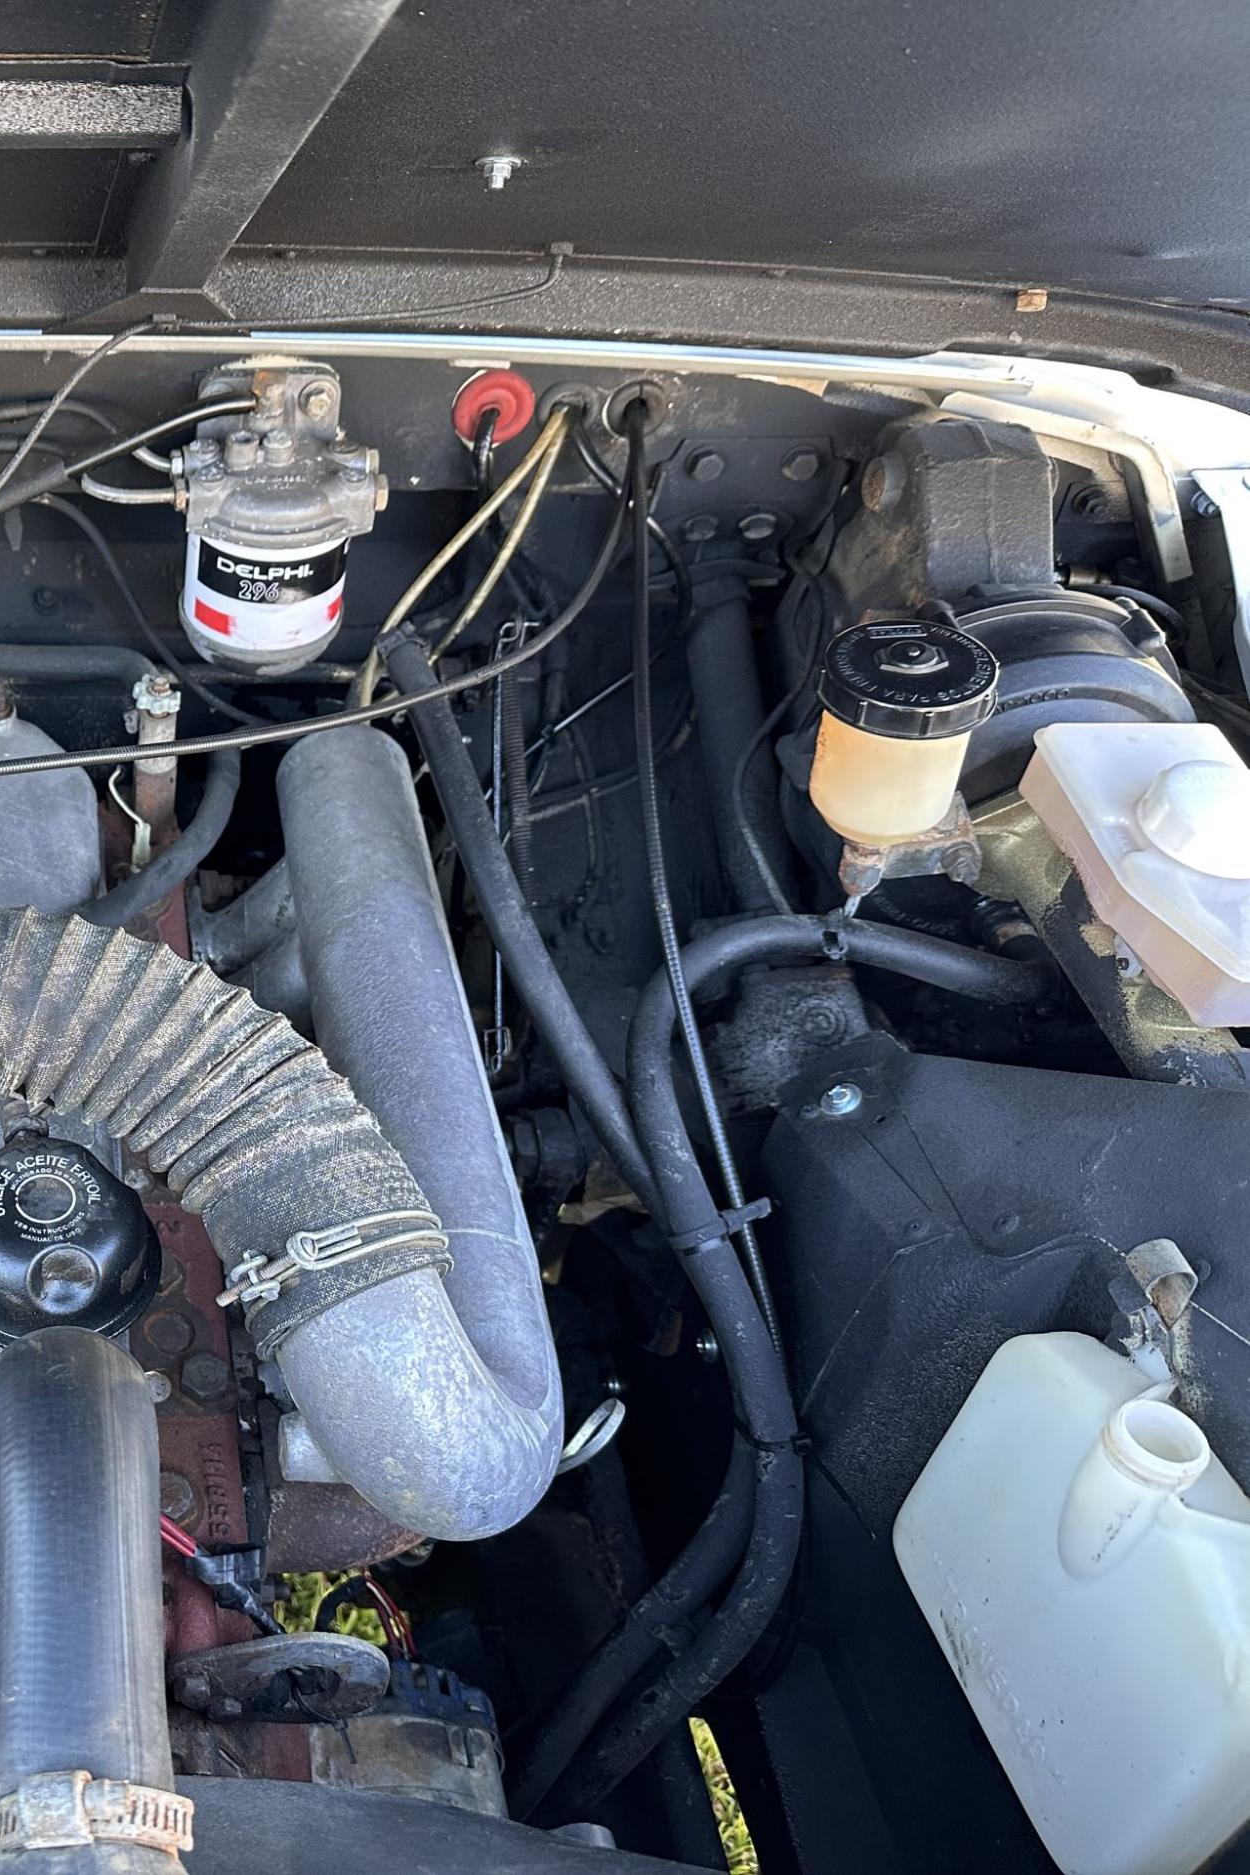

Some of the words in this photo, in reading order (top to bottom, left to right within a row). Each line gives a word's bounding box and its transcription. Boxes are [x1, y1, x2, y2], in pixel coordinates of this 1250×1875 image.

[216, 556, 310, 580] DELPHI
[238, 579, 280, 601] 296
[15, 1154, 70, 1173] ACEITE
[20, 1232, 52, 1243] MANUAL
[53, 1234, 64, 1242] DE
[65, 1227, 82, 1239] USO
